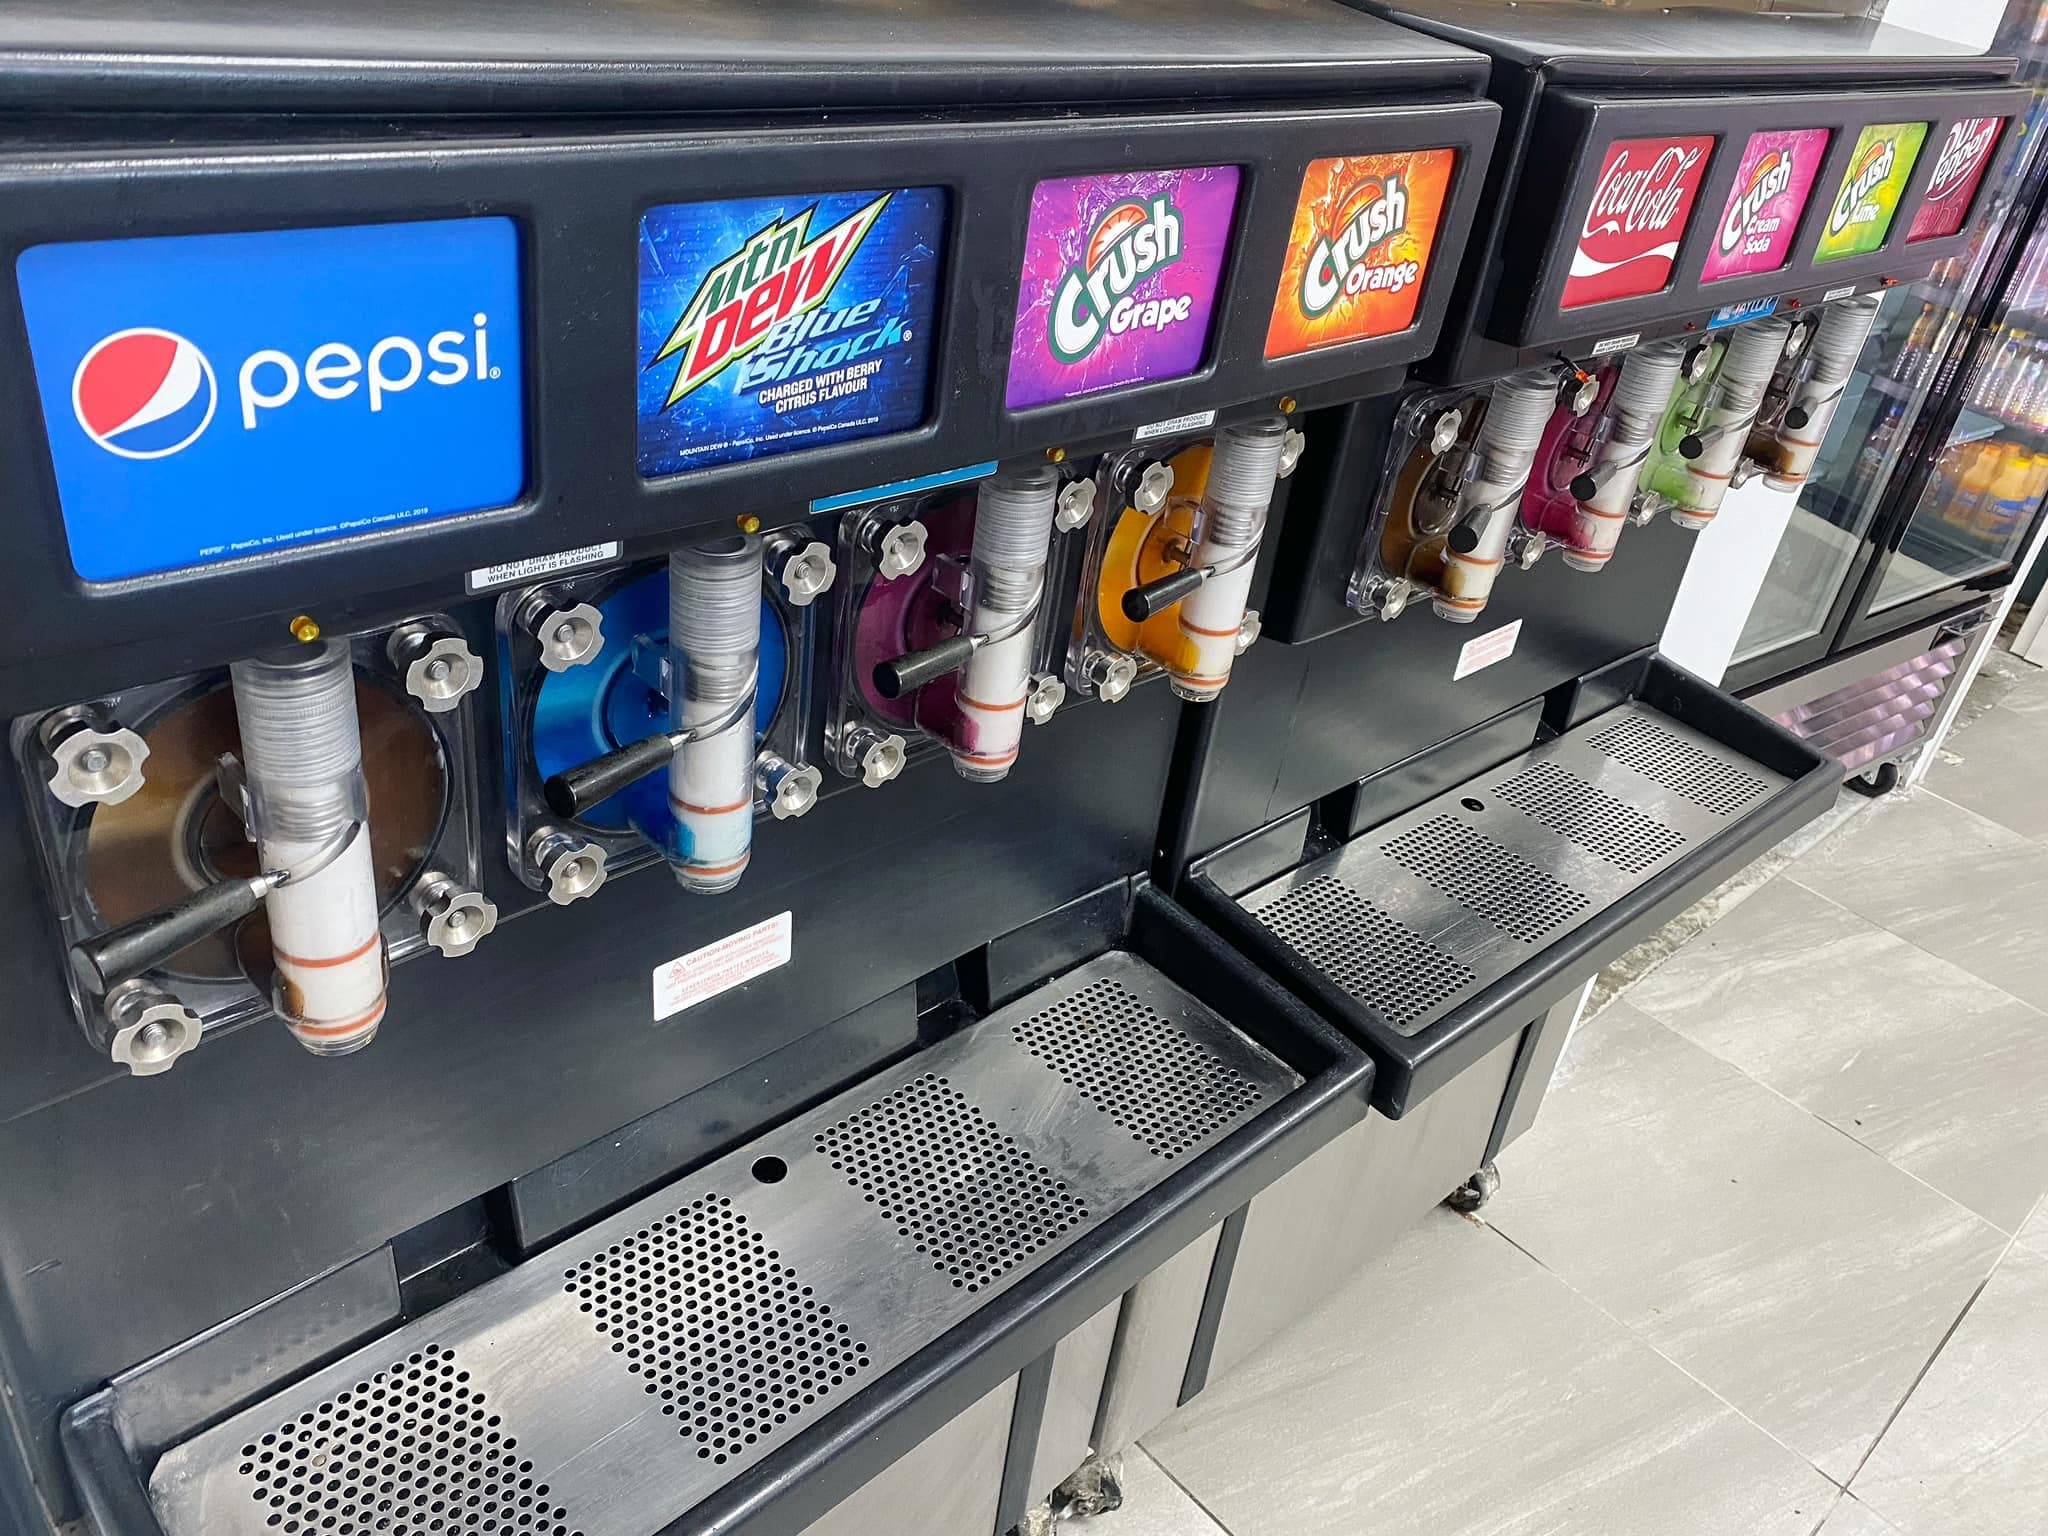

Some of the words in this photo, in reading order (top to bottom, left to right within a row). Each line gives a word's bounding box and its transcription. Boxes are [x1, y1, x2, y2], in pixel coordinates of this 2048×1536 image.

[1721, 150, 1792, 251] Crush
[1831, 140, 1894, 232] Crush
[1747, 215, 1781, 235] Cream
[1305, 178, 1407, 312] Crush
[1744, 235, 1771, 255] Soda
[1053, 201, 1180, 355] Crush
[1345, 262, 1418, 295] Orange
[754, 298, 882, 356] Blue
[1109, 295, 1192, 334] Grape
[759, 377, 814, 405] CHARGED
[815, 368, 845, 389] WITH
[846, 359, 883, 381] BERRY
[775, 390, 817, 414] CITRUS
[818, 377, 868, 402] FLAVOUR
[487, 571, 516, 583] WHEN
[518, 562, 546, 576] LIGHT
[548, 561, 557, 569] IS
[559, 551, 604, 567] FLASHING
[489, 565, 503, 575] DO
[506, 560, 525, 571] NOT
